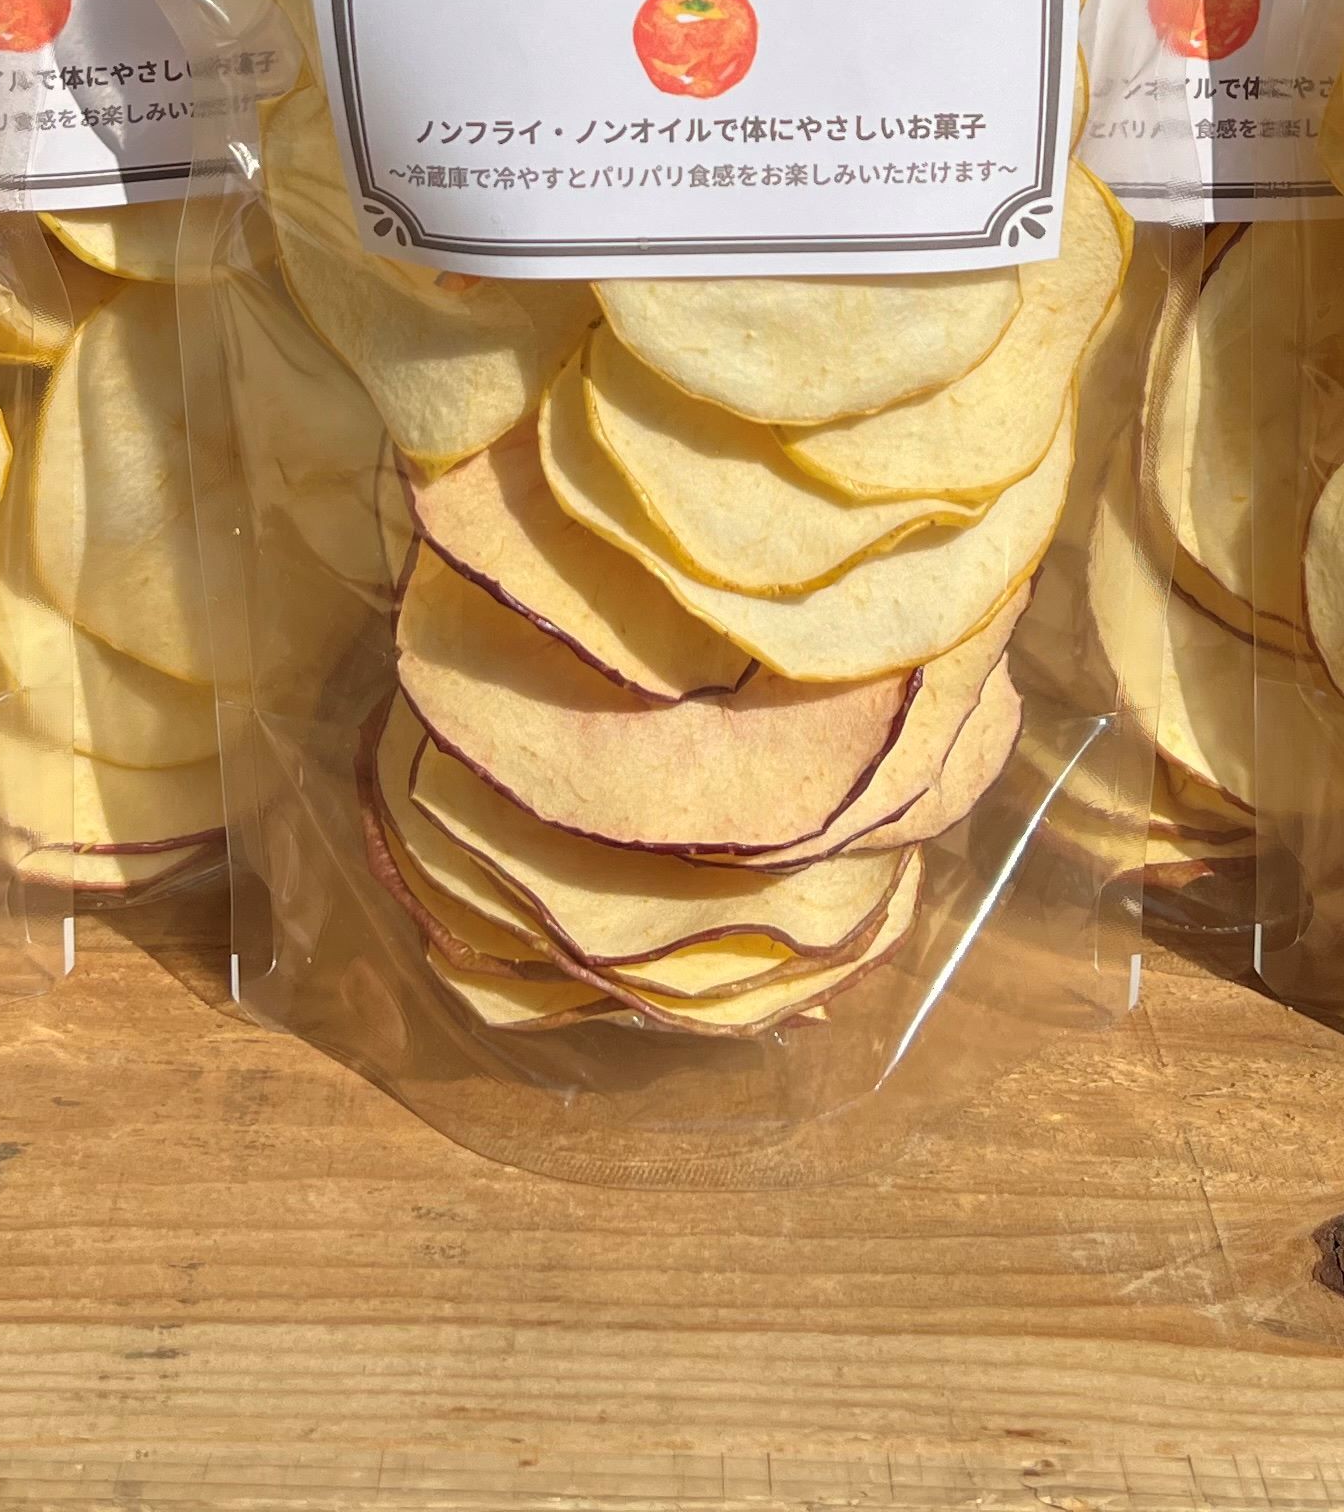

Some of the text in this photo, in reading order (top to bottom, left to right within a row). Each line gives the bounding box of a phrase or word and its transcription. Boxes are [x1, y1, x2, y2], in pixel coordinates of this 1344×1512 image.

[416, 113, 987, 144] ノンフライ・ノンオイルで体にやさしいお菓子
